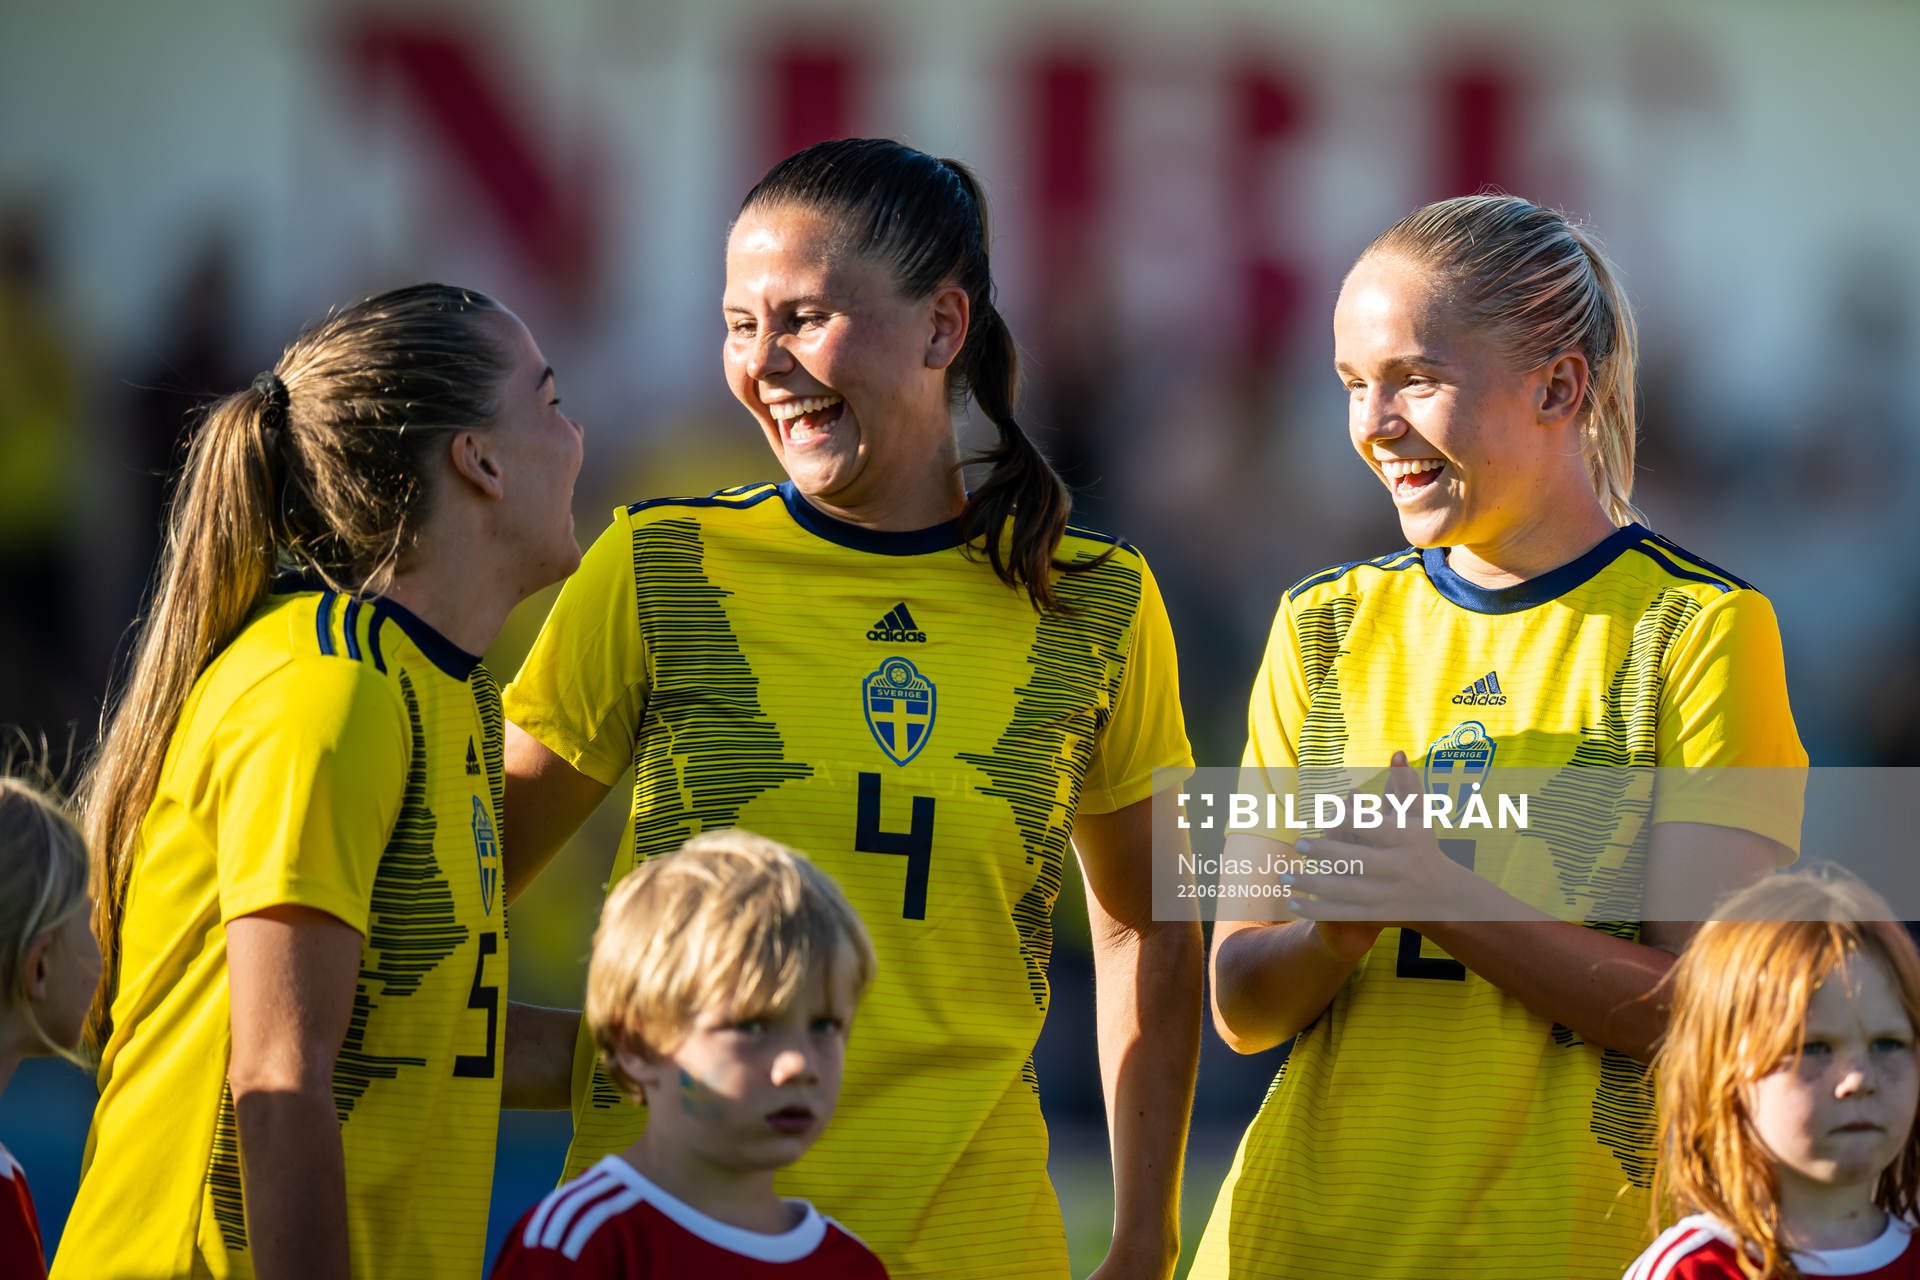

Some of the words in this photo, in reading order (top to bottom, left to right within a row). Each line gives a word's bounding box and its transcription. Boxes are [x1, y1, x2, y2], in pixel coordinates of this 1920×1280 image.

[866, 624, 927, 643] adidas
[877, 688, 922, 699] SVERIGE
[1451, 694, 1507, 706] adidas
[1441, 751, 1482, 759] SVERIGE
[855, 772, 936, 920] 4
[452, 931, 499, 1079] 5
